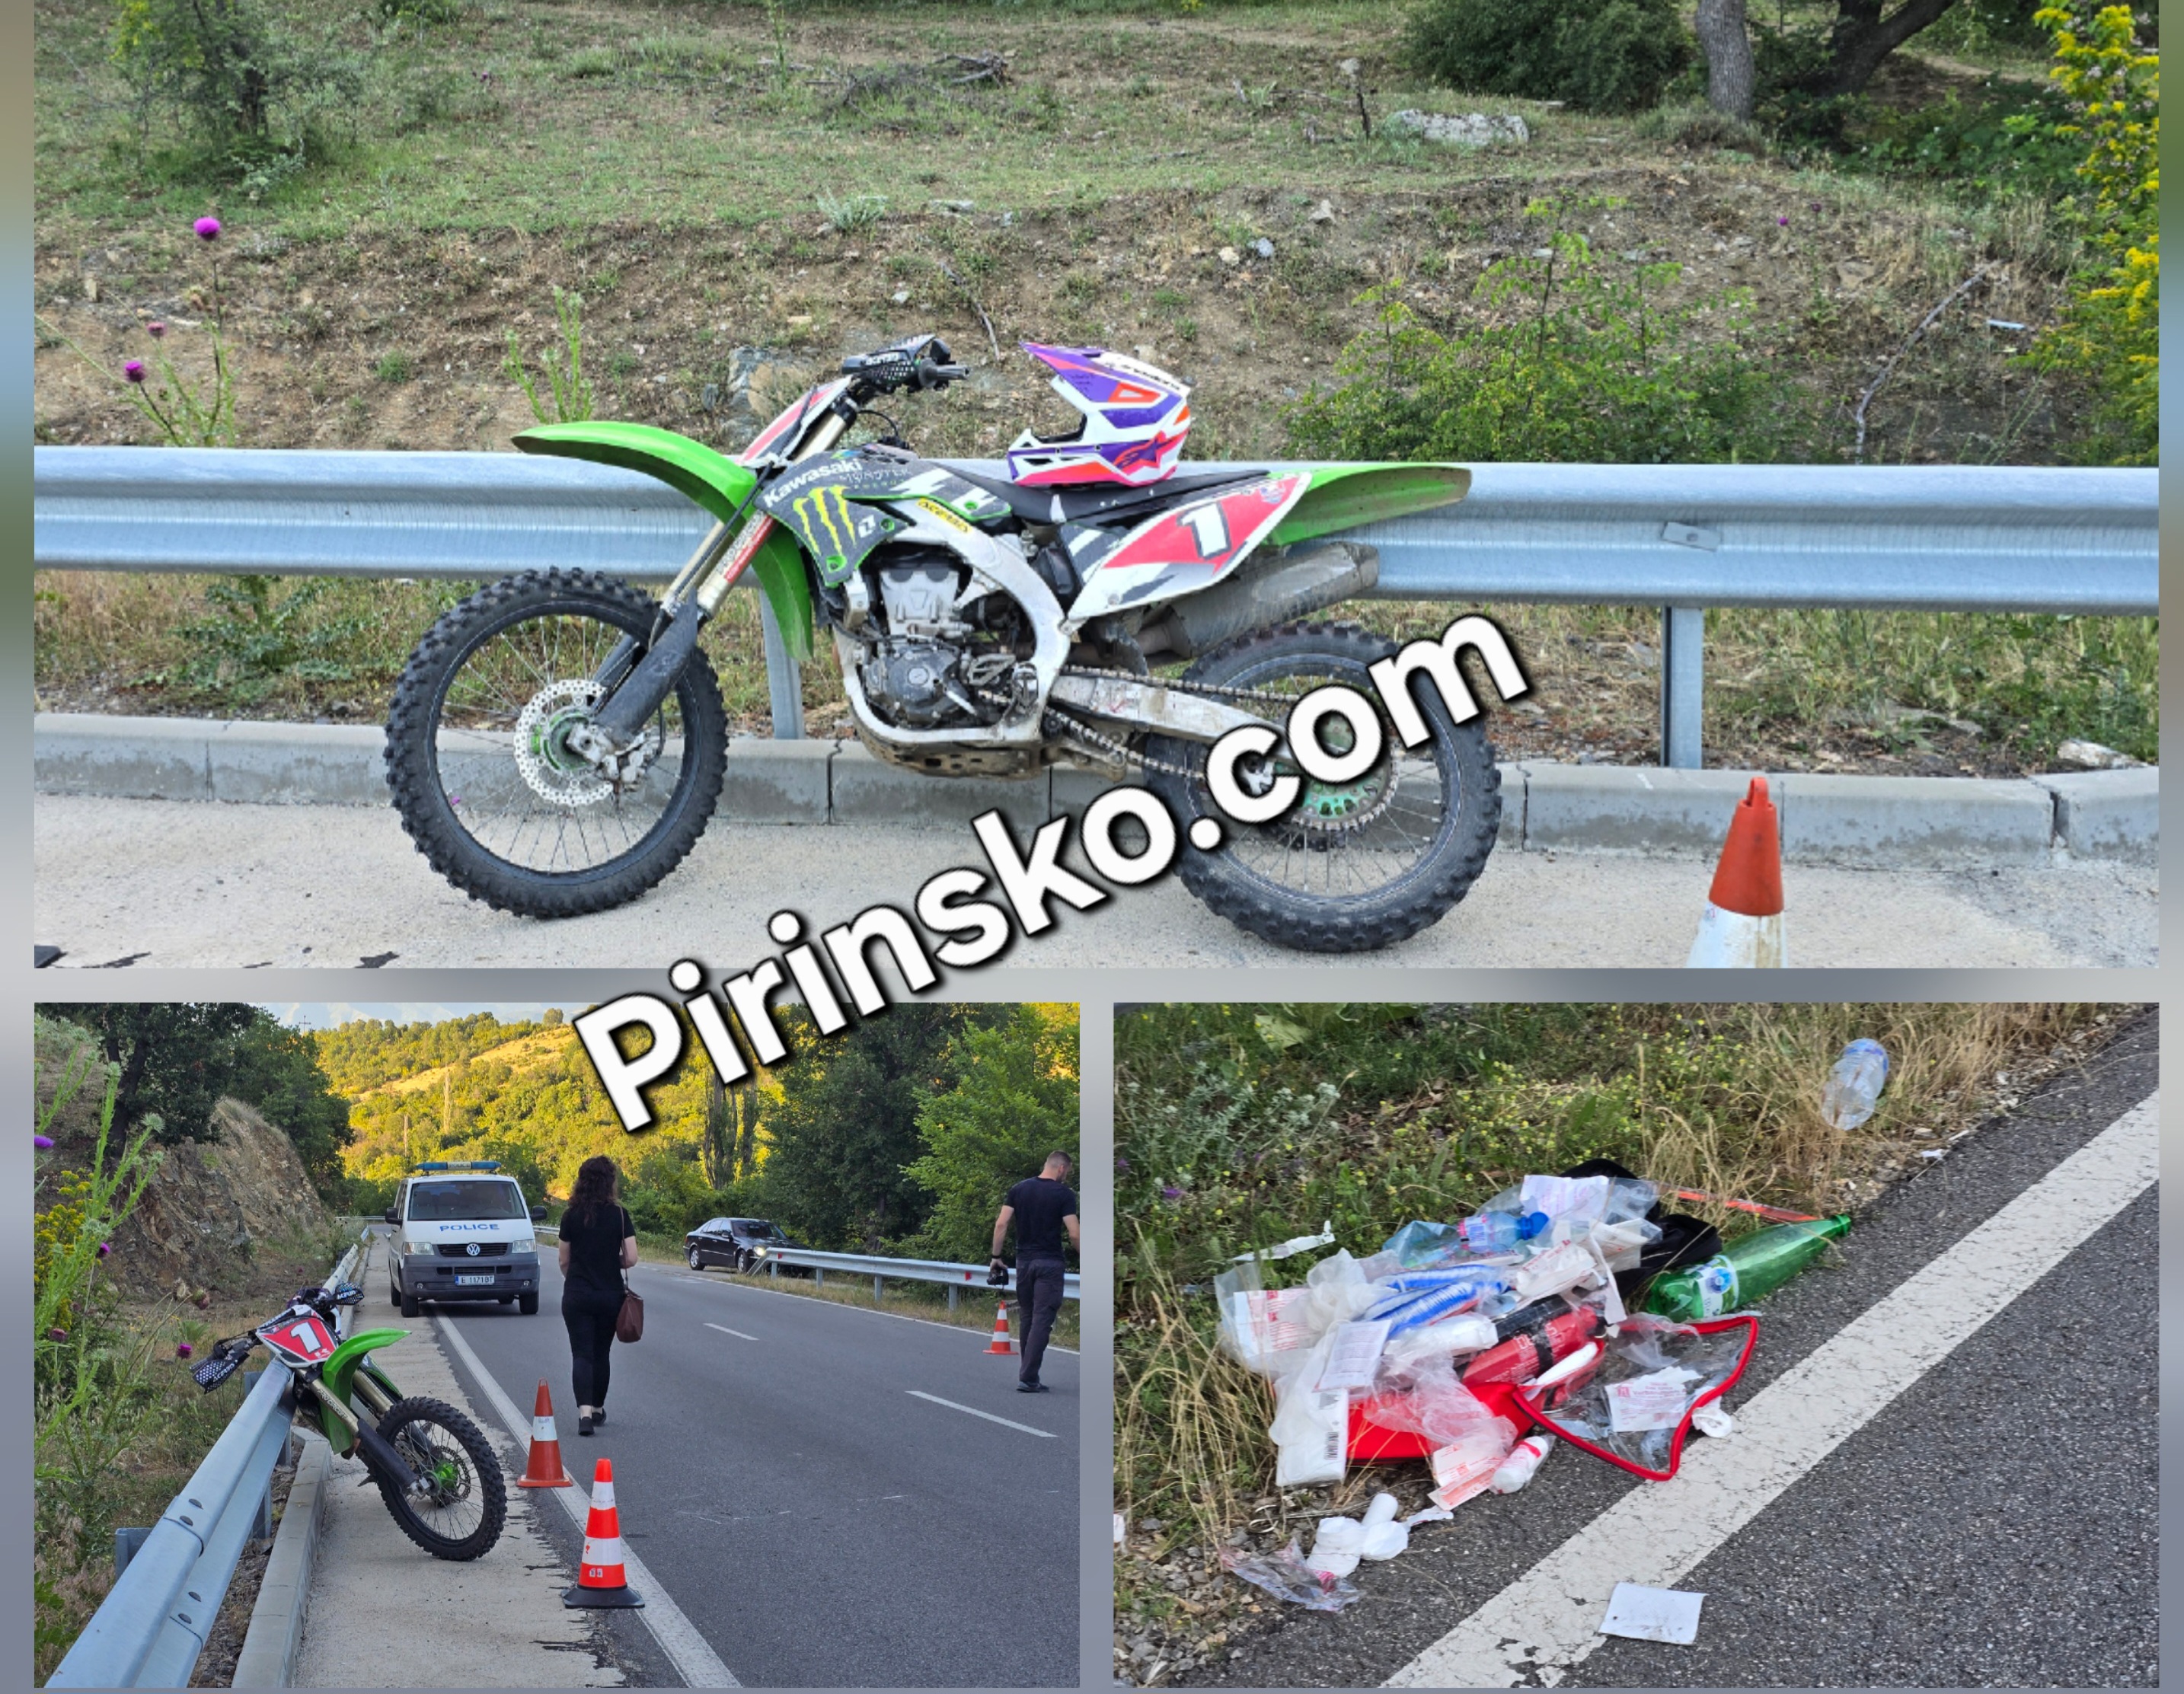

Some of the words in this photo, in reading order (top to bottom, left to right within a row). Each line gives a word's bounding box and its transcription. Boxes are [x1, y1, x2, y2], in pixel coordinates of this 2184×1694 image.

[762, 458, 863, 508] Kawasaki
[1177, 502, 1231, 558] 1
[439, 1223, 500, 1232] POLICE
[290, 1321, 322, 1354] 1
[318, 1388, 329, 1401] PRO
[327, 1398, 349, 1420] CIRCUIT
